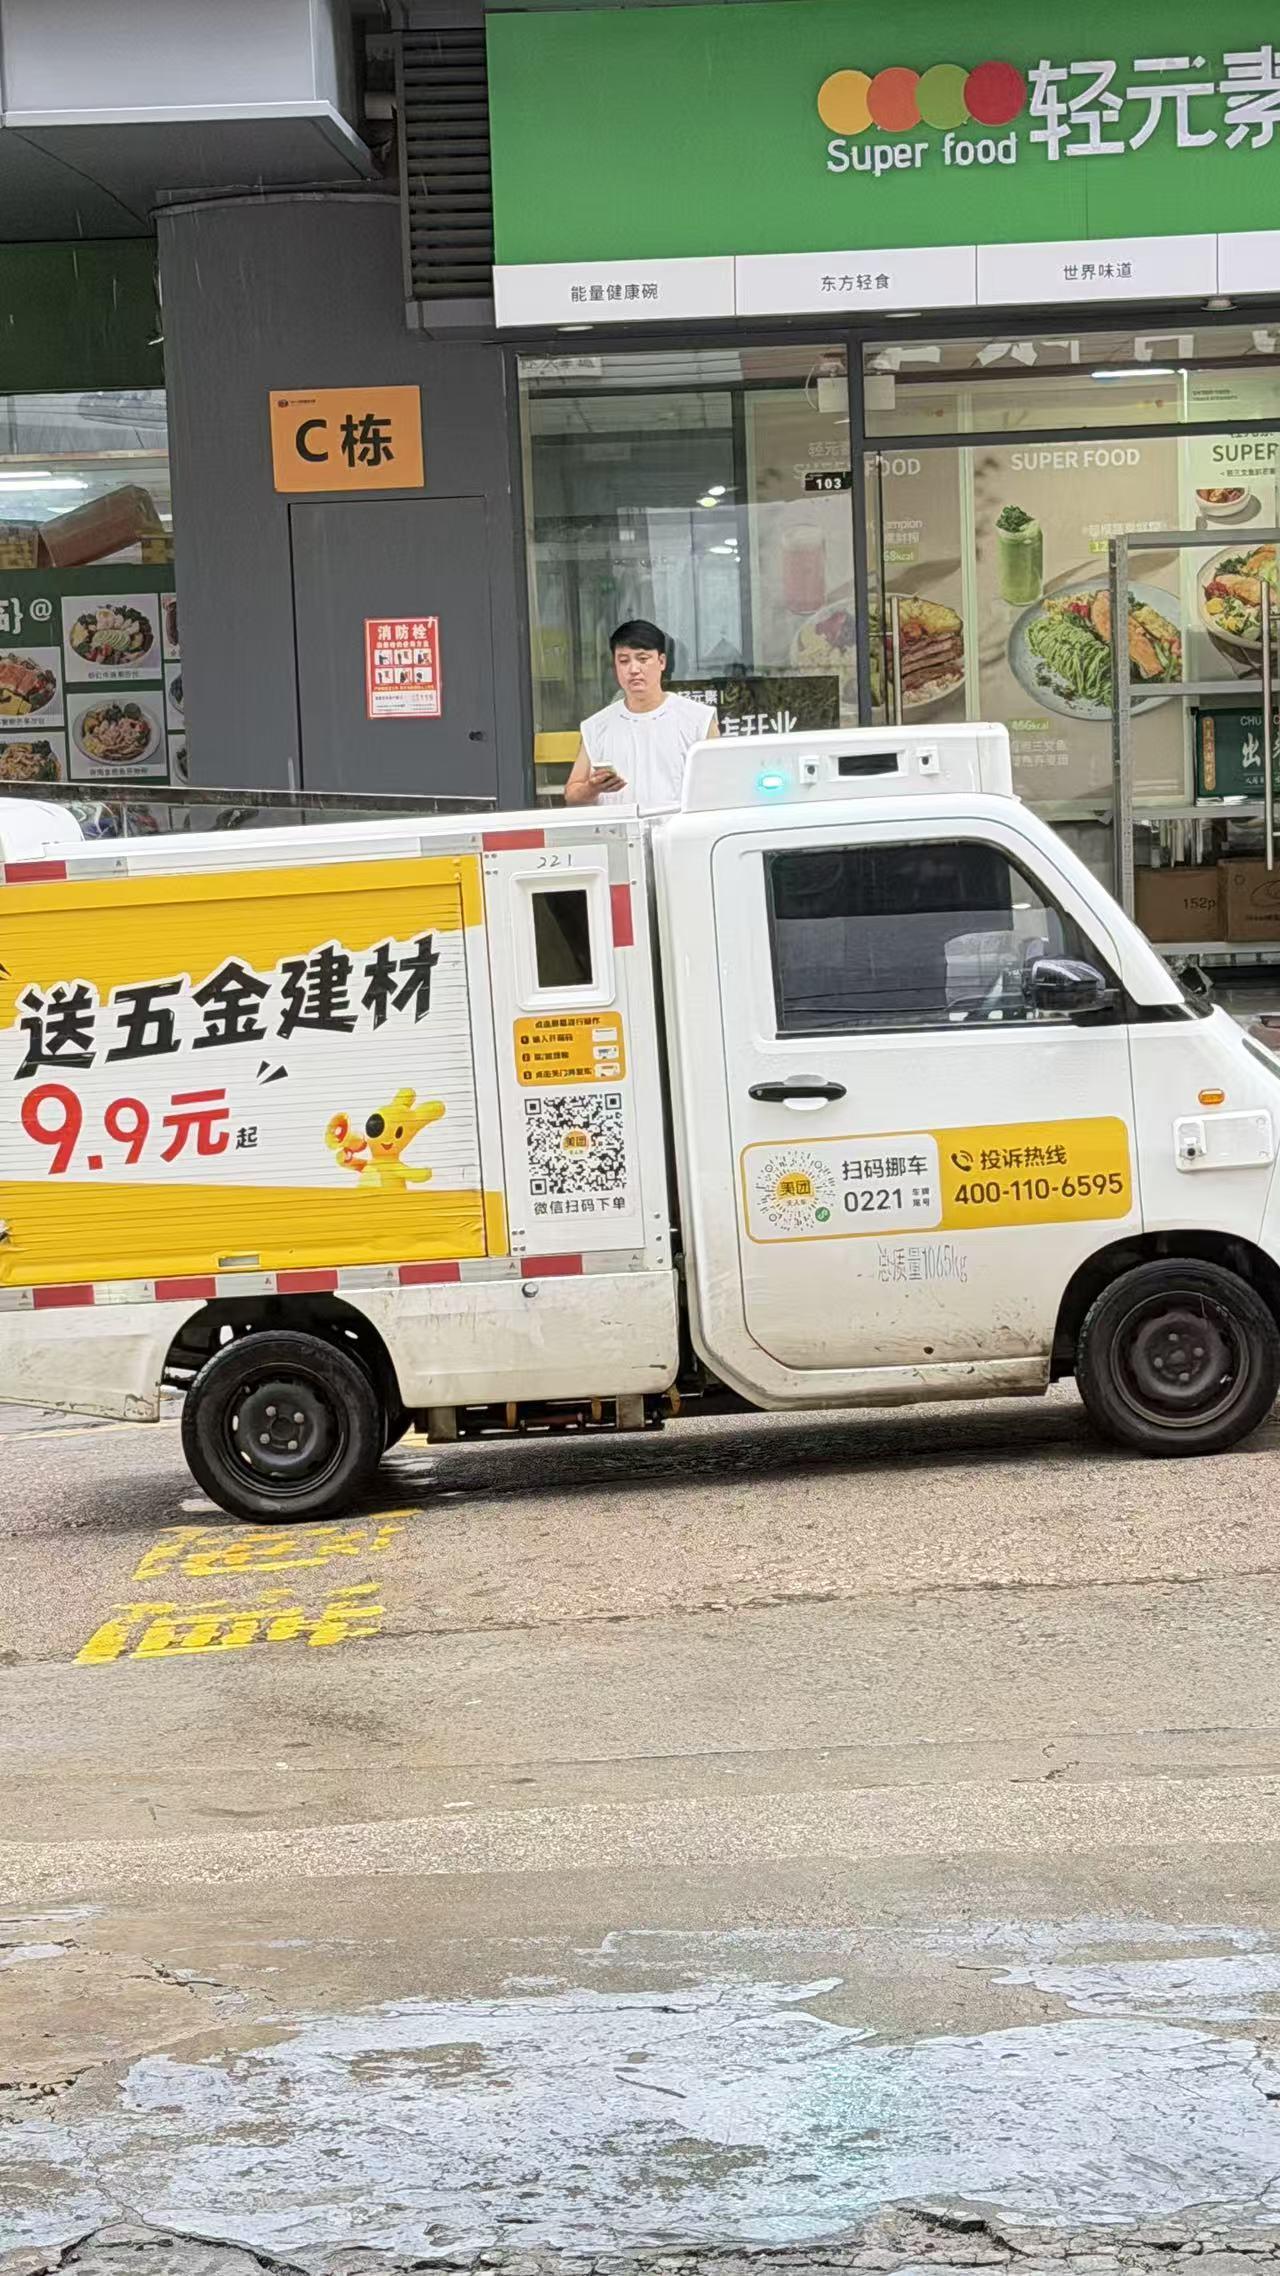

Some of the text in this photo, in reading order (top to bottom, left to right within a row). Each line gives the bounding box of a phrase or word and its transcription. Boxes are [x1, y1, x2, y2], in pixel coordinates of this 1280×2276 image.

[1028, 45, 1280, 161] 轻元素
[827, 131, 1018, 176] Super food
[1062, 260, 1132, 280] 世界味道
[819, 271, 890, 292] 东方轻食
[570, 282, 659, 304] 能量健康碗
[1011, 448, 1140, 471] SUPER FOOD
[1212, 443, 1279, 462] SUPER
[815, 478, 842, 489] 103
[377, 624, 427, 640] 消防栓
[1240, 716, 1262, 726] CHU
[537, 854, 572, 869] 221
[14, 932, 441, 1081] 送五金建材
[842, 1155, 928, 1181] 扫码挪车
[980, 1145, 1068, 1171] 投诉热线
[780, 1180, 811, 1197] 美团
[954, 1172, 1123, 1206] 400-110-6595
[533, 1197, 625, 1215] 微信扫码下单
[844, 1188, 902, 1212] 0221
[877, 1242, 968, 1283] 总质量1065kg
